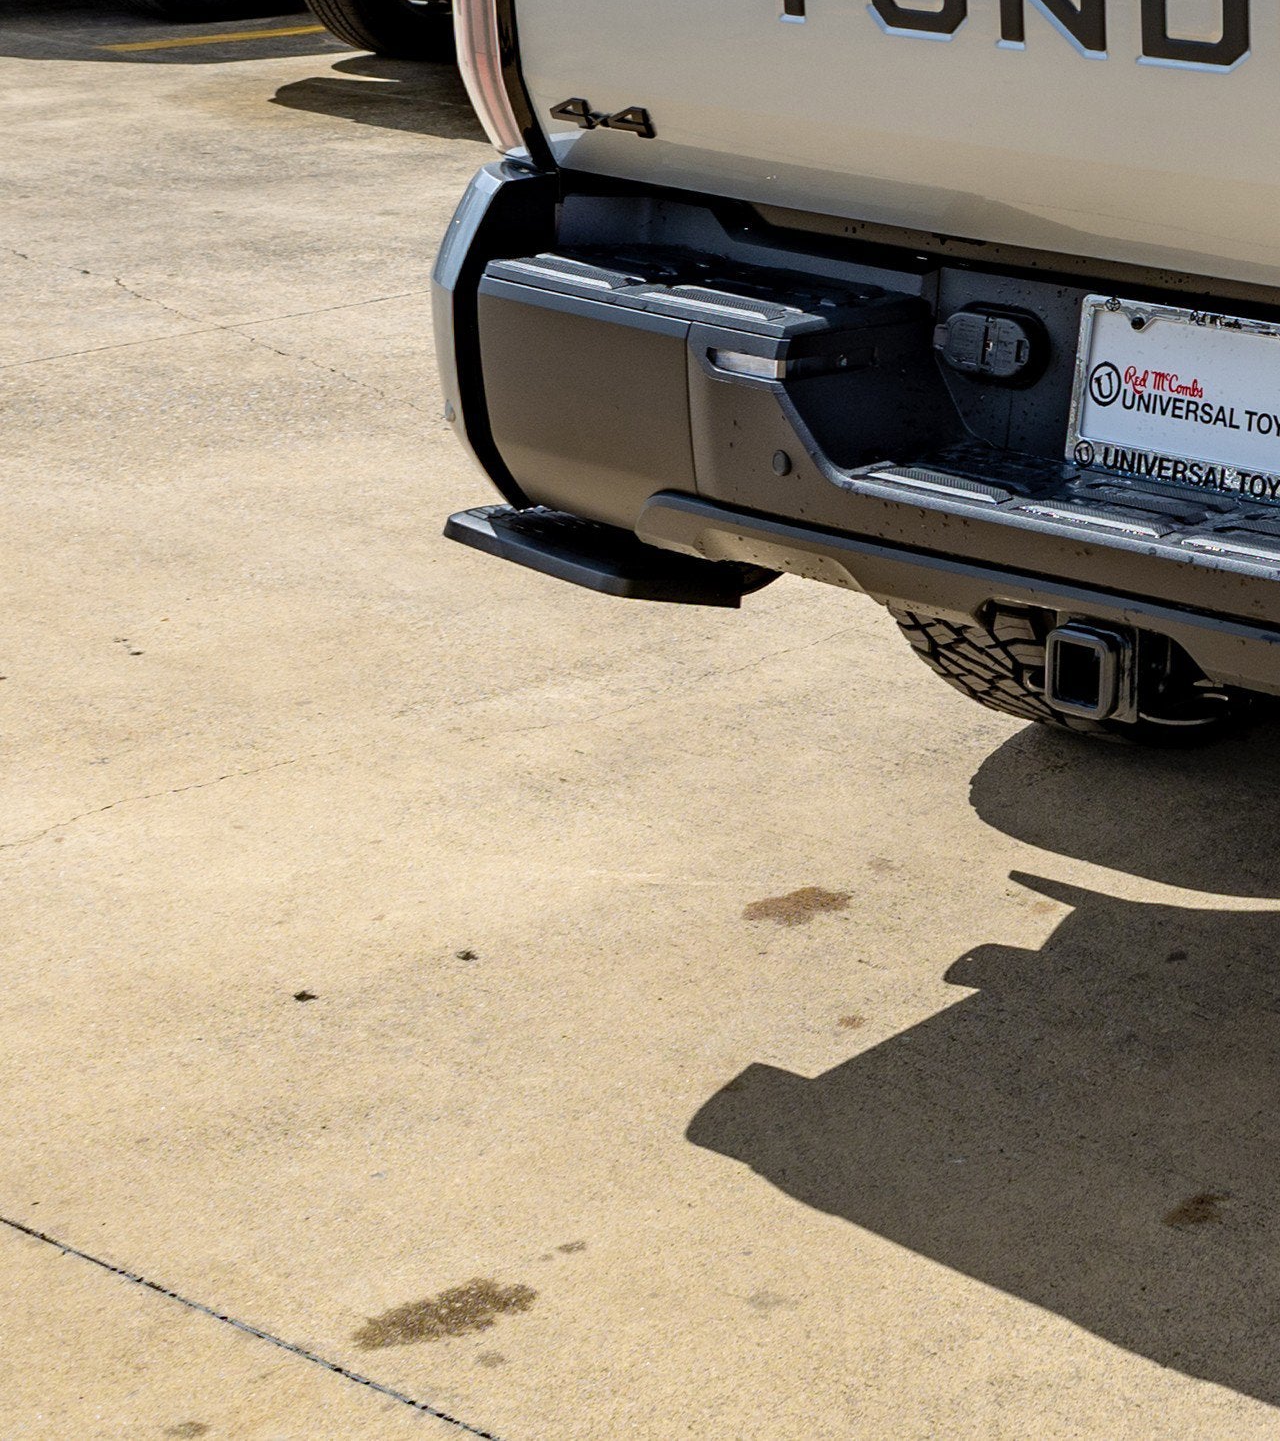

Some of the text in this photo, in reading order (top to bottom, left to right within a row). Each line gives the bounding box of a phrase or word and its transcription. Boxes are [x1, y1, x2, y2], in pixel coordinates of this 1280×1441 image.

[549, 97, 657, 139] 4x4
[1124, 365, 1203, 398] Red McCombs
[1121, 389, 1240, 429] UNIVERSAL
[1103, 447, 1234, 492] UNIVERSAL
